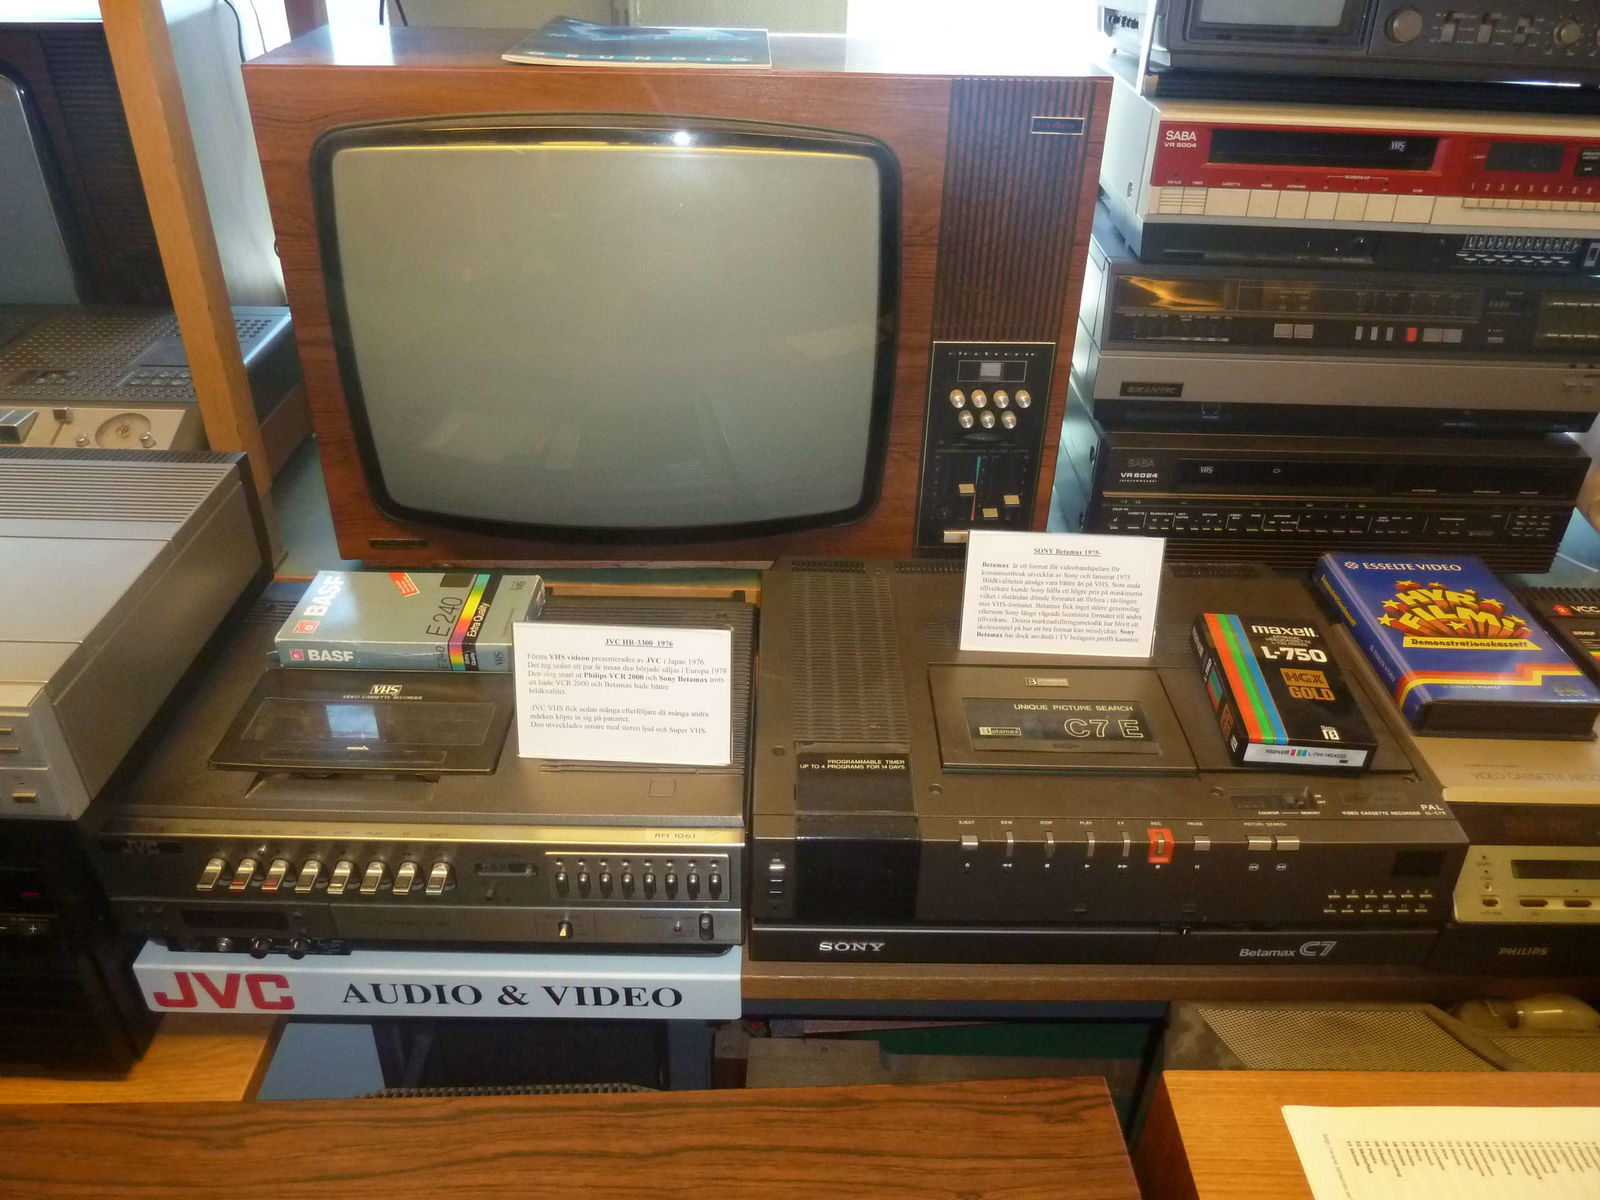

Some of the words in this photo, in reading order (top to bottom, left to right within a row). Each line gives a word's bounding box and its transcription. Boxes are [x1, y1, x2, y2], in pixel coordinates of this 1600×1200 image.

[1165, 130, 1197, 141] SABA
[1055, 548, 1082, 556] Betamax
[1362, 562, 1415, 571] ESSELTE
[1415, 563, 1462, 571] VIDEO
[303, 575, 345, 616] BASF
[1395, 589, 1479, 607] HYR
[1251, 625, 1317, 637] maxell
[605, 638, 622, 646] JVC
[657, 639, 674, 647] 1976
[1411, 638, 1528, 648] Demonstrationskassett
[307, 649, 354, 662] BASF
[1261, 646, 1328, 663] L-750
[584, 672, 607, 680] Philips
[608, 672, 626, 680] VCR
[658, 675, 675, 683] Sony
[1283, 671, 1325, 684] HGX
[371, 684, 402, 695] VHS
[1288, 686, 1336, 701] GOLD
[1014, 703, 1049, 711] UNIQUE
[1064, 718, 1110, 738] C7
[1117, 719, 1144, 738] E
[1420, 803, 1445, 811] PAL
[818, 942, 886, 951] SONY
[1239, 948, 1297, 957] Betamax
[1299, 941, 1338, 957] C7
[1498, 947, 1549, 955] PHILIPS
[153, 971, 296, 1011] JVC
[341, 983, 483, 1006] AUDIO
[497, 985, 530, 1006] &
[540, 985, 683, 1008] VIDEO
